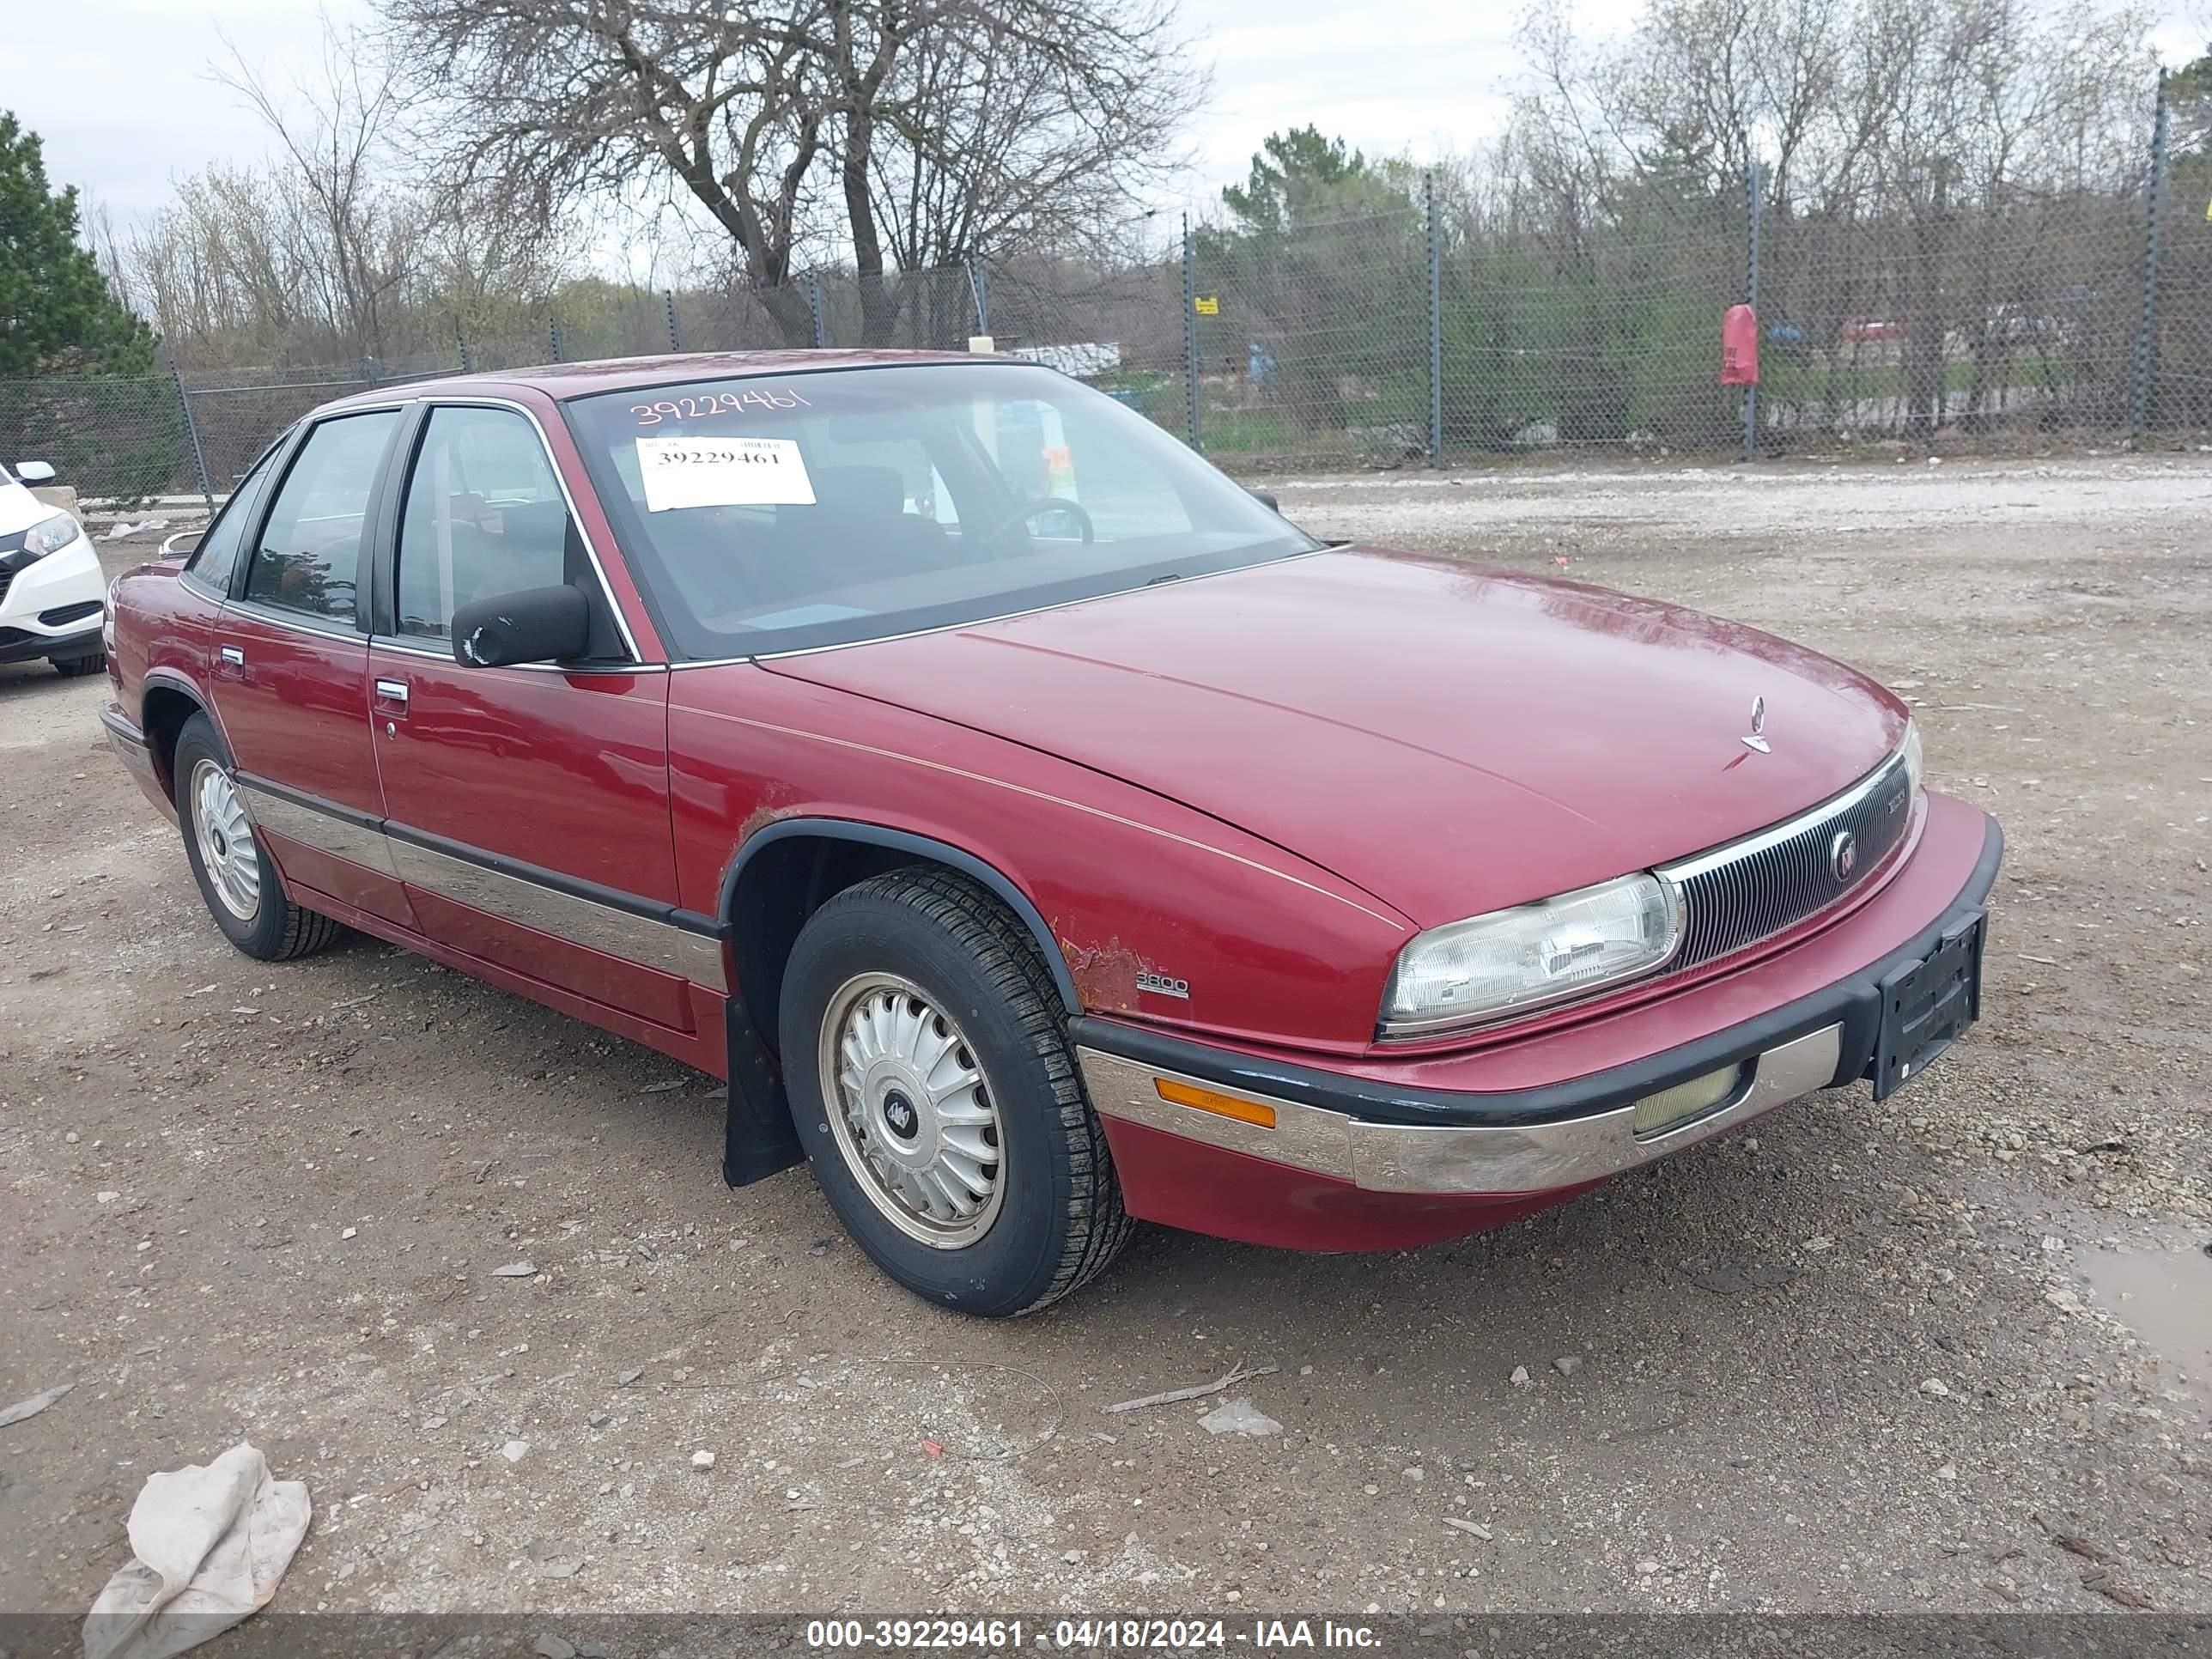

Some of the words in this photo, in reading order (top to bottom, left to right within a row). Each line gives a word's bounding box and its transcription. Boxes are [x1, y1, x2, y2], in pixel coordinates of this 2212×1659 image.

[630, 389, 813, 425] 39229461
[659, 452, 781, 465] 39229461
[1136, 972, 1189, 993] 3800
